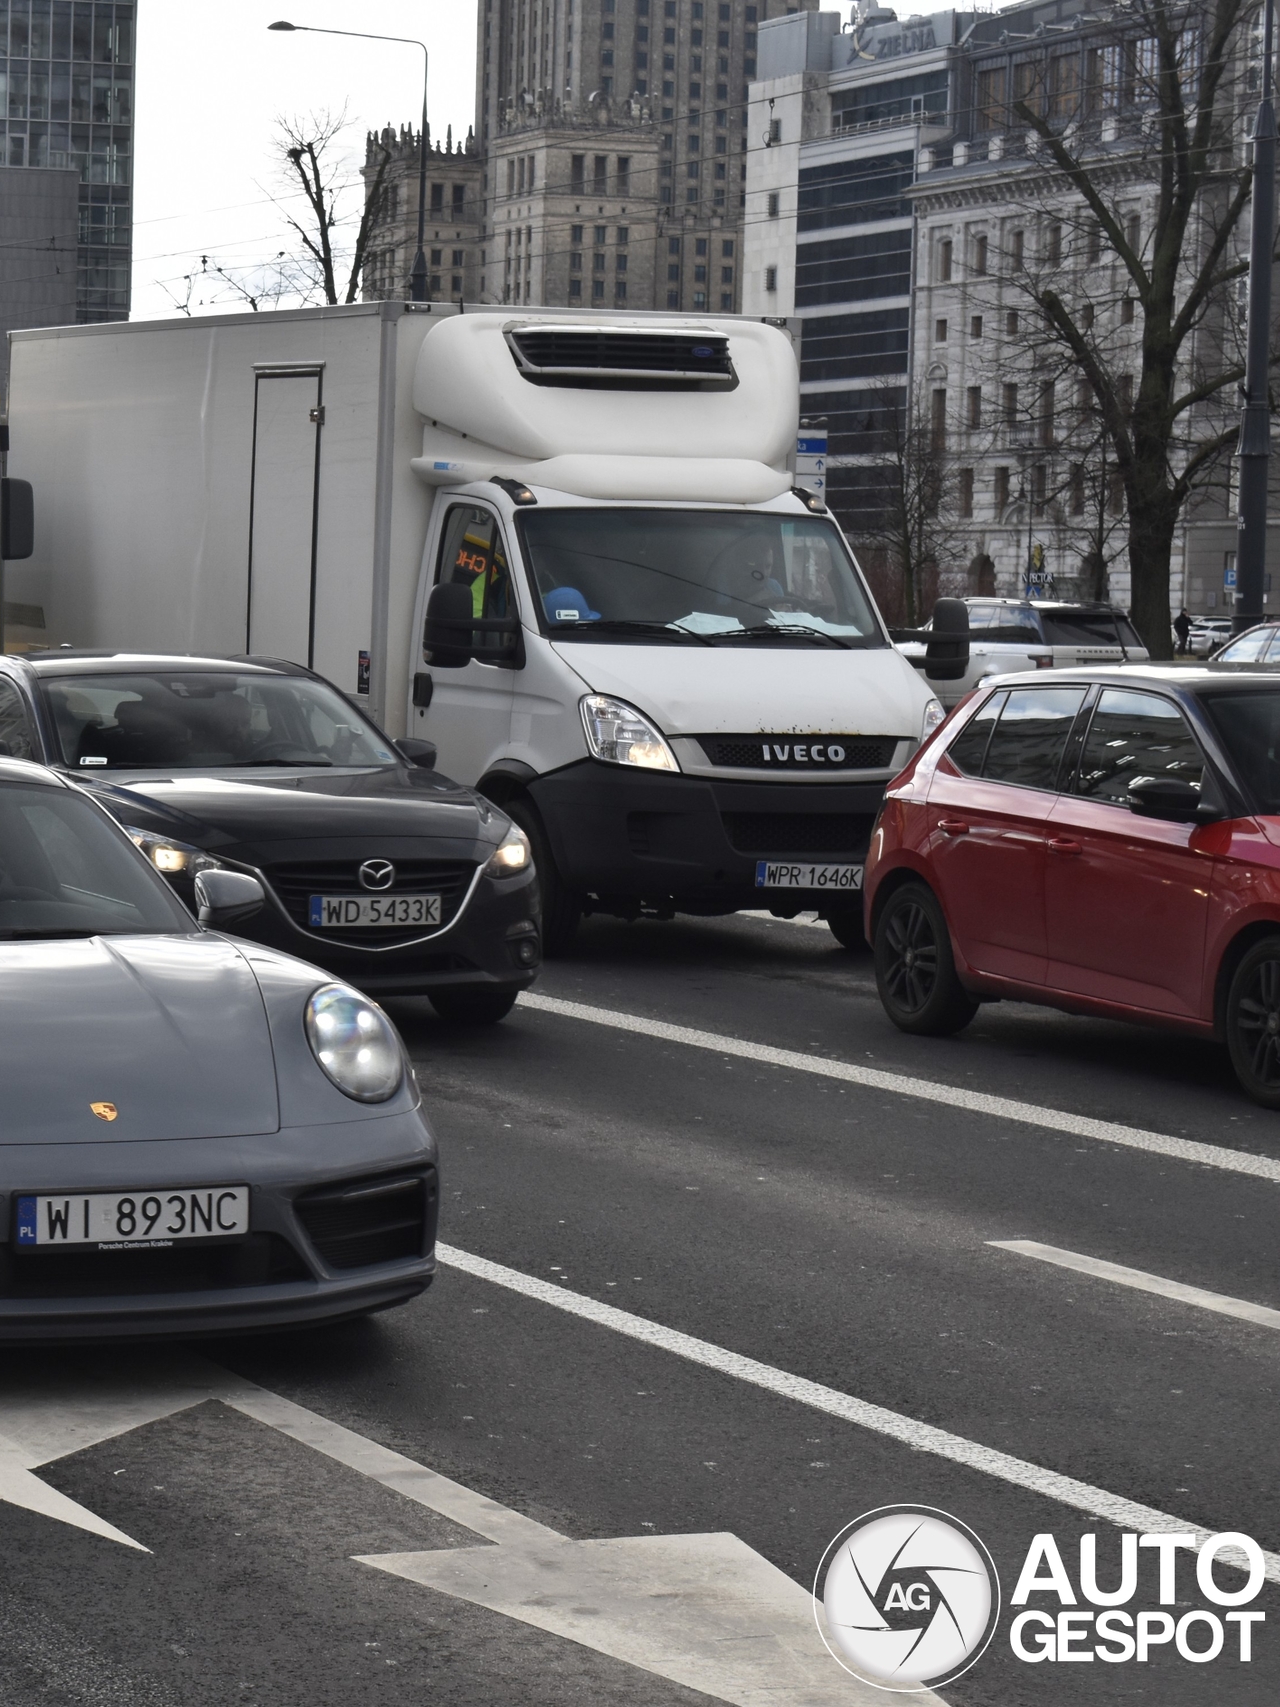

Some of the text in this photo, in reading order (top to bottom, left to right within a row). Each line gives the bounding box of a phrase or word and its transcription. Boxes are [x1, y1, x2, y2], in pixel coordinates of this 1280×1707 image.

[876, 27, 937, 58] ZIELNA
[762, 744, 846, 762] IVECO
[767, 865, 801, 886] WPR
[809, 866, 862, 888] 1646K
[326, 900, 361, 924] WD
[369, 898, 438, 923] 5433K
[20, 1191, 238, 1240] PL WI 893NC
[98, 1242, 123, 1250] Porsche
[123, 1241, 150, 1249] Centrum
